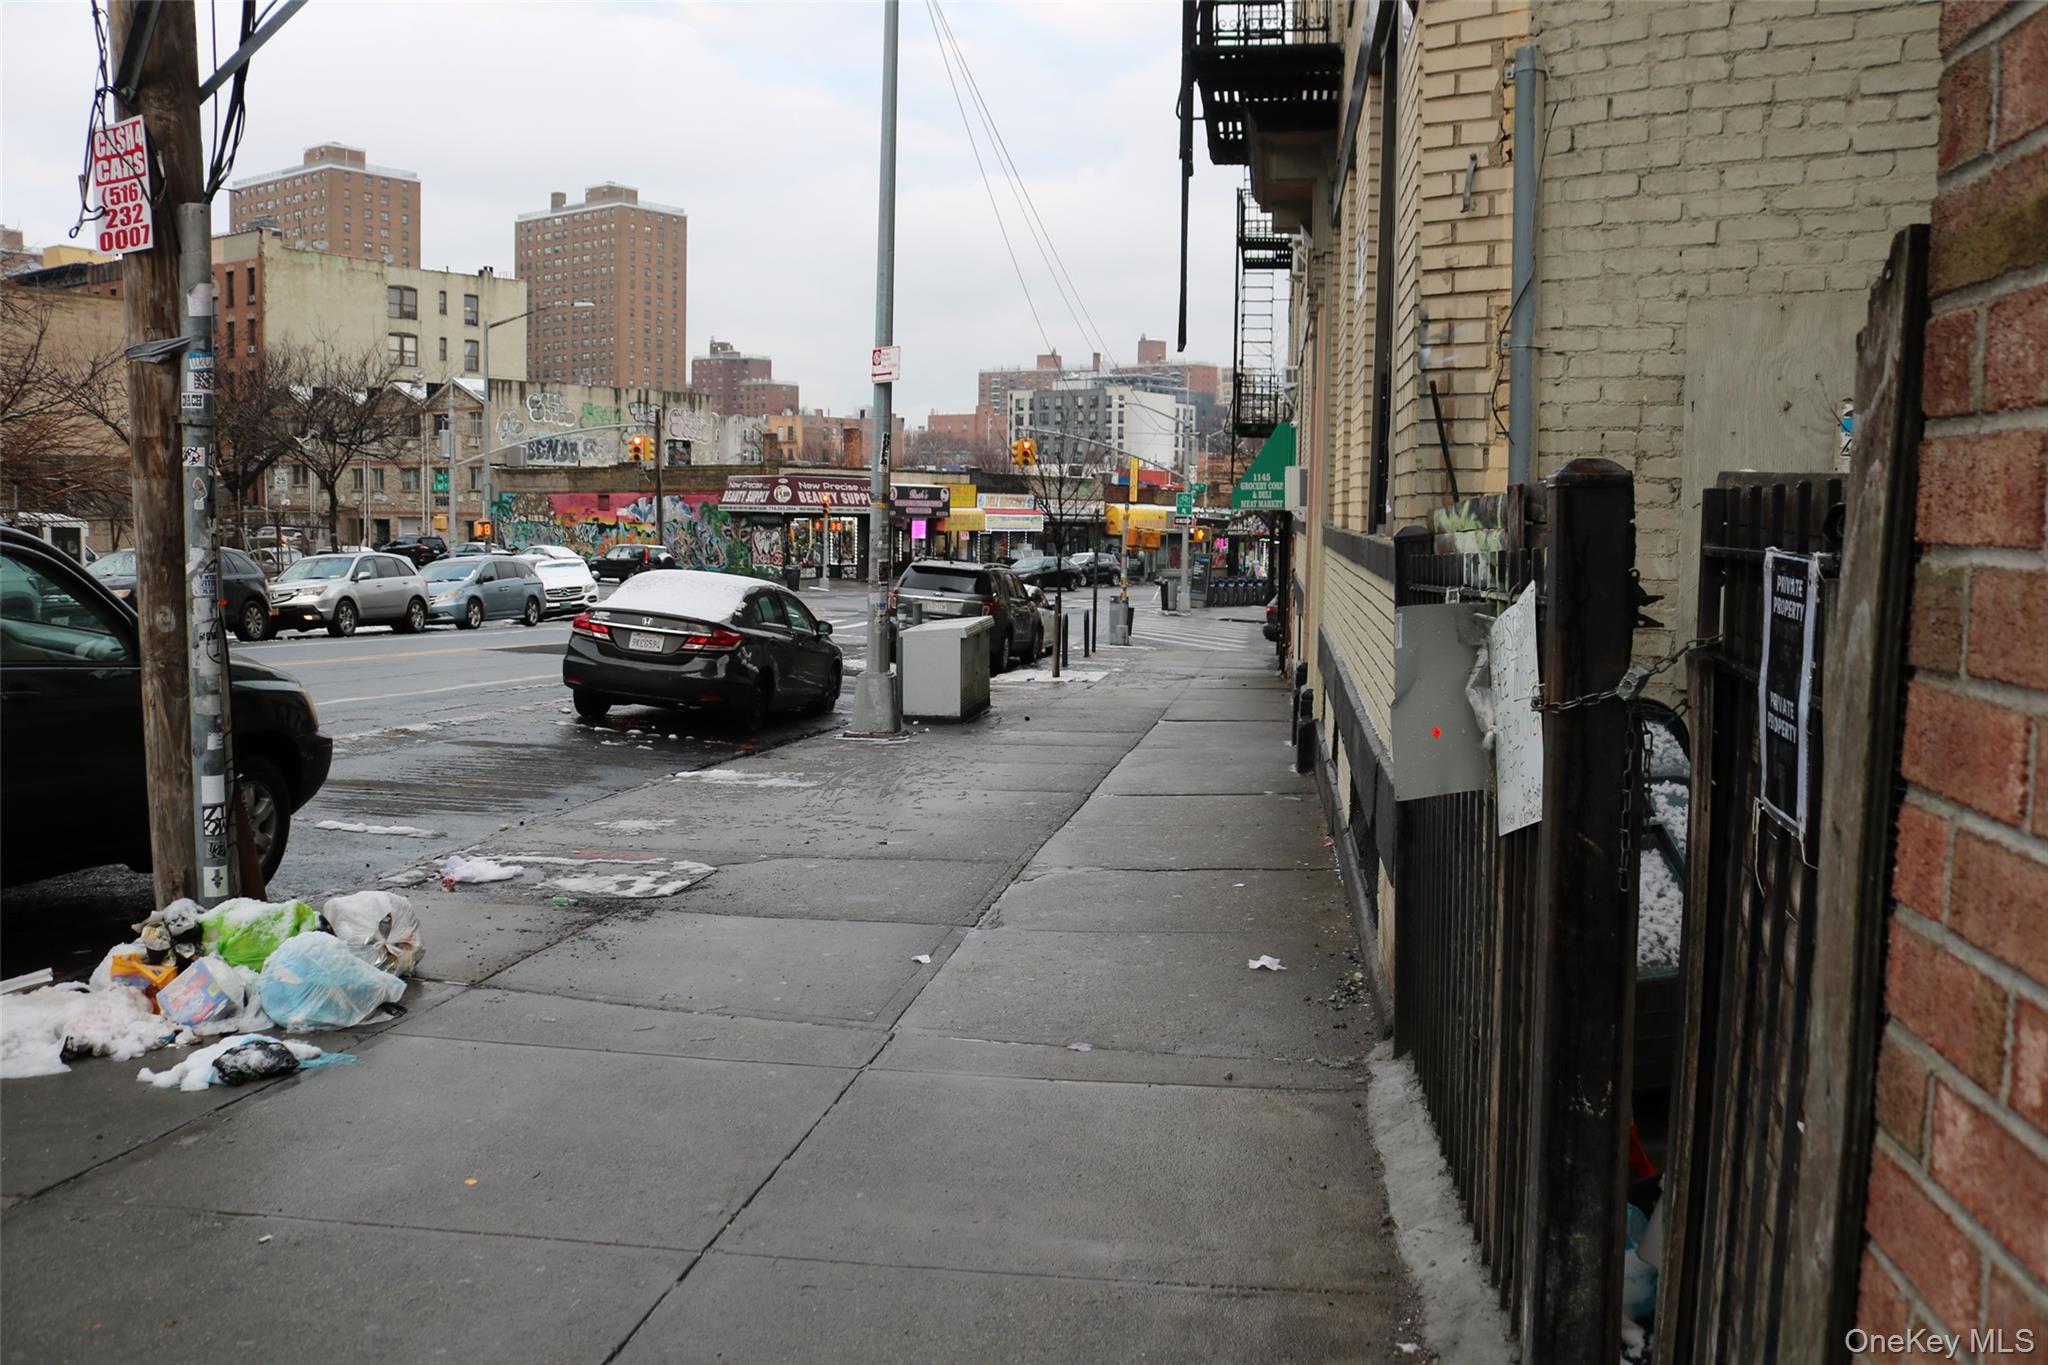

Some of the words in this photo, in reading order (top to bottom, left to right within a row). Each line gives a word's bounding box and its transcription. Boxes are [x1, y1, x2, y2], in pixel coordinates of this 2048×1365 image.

[96, 151, 145, 183] CARS
[101, 182, 144, 207] (516)
[105, 203, 143, 229] 232
[99, 224, 150, 251] 0007
[722, 490, 748, 502] BEAUTY
[746, 490, 770, 503] SUPPLY
[798, 481, 820, 490] New
[822, 482, 859, 491] Precise
[1240, 482, 1267, 490] GROCERY
[1258, 491, 1272, 499] DELI
[1240, 500, 1257, 508] MEAT
[1258, 500, 1283, 508] MARKET
[1776, 575, 1804, 598] PRIVATE
[1773, 596, 1805, 622] PROPERTY
[1770, 690, 1795, 720] PRIVATE
[1767, 711, 1797, 744] PROPERTY
